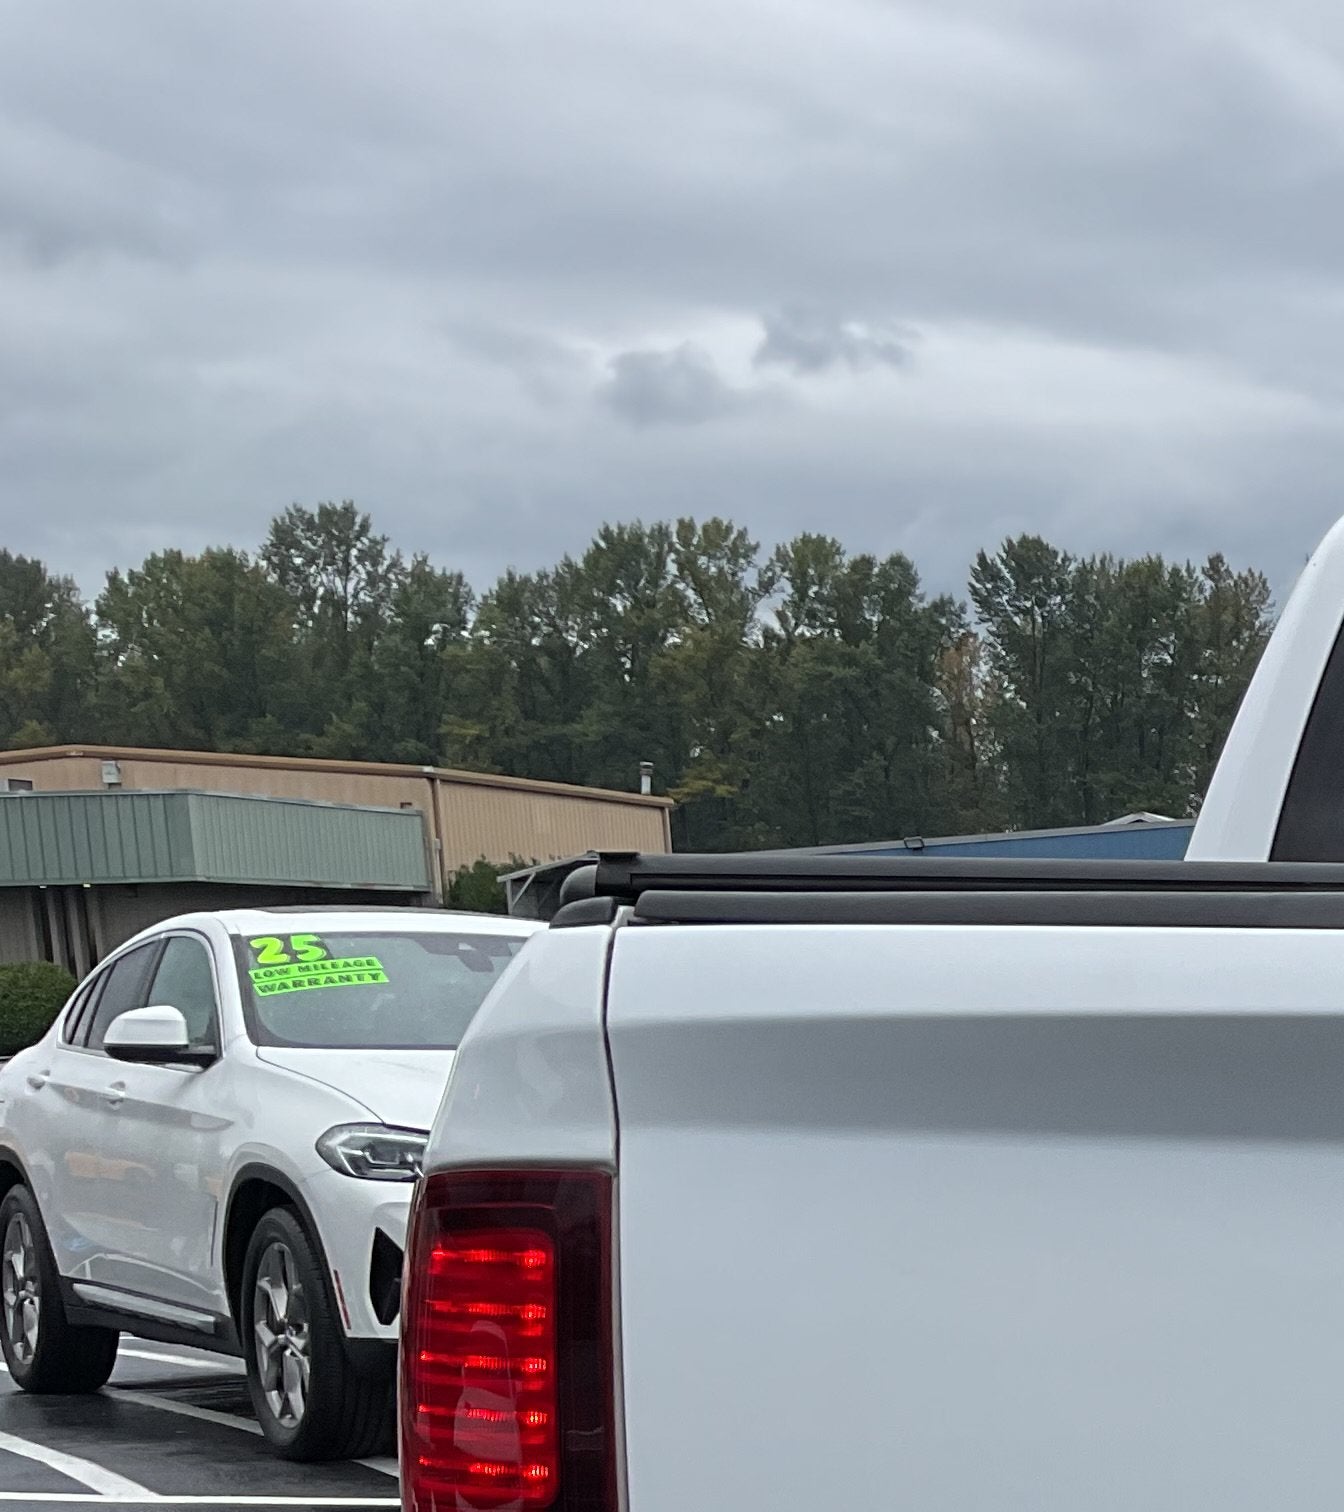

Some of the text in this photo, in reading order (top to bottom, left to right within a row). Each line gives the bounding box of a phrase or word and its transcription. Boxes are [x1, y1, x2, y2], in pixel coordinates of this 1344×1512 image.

[250, 934, 327, 964] 25
[254, 958, 376, 980] LOW MILEAGE
[257, 972, 382, 993] WARRANTY
